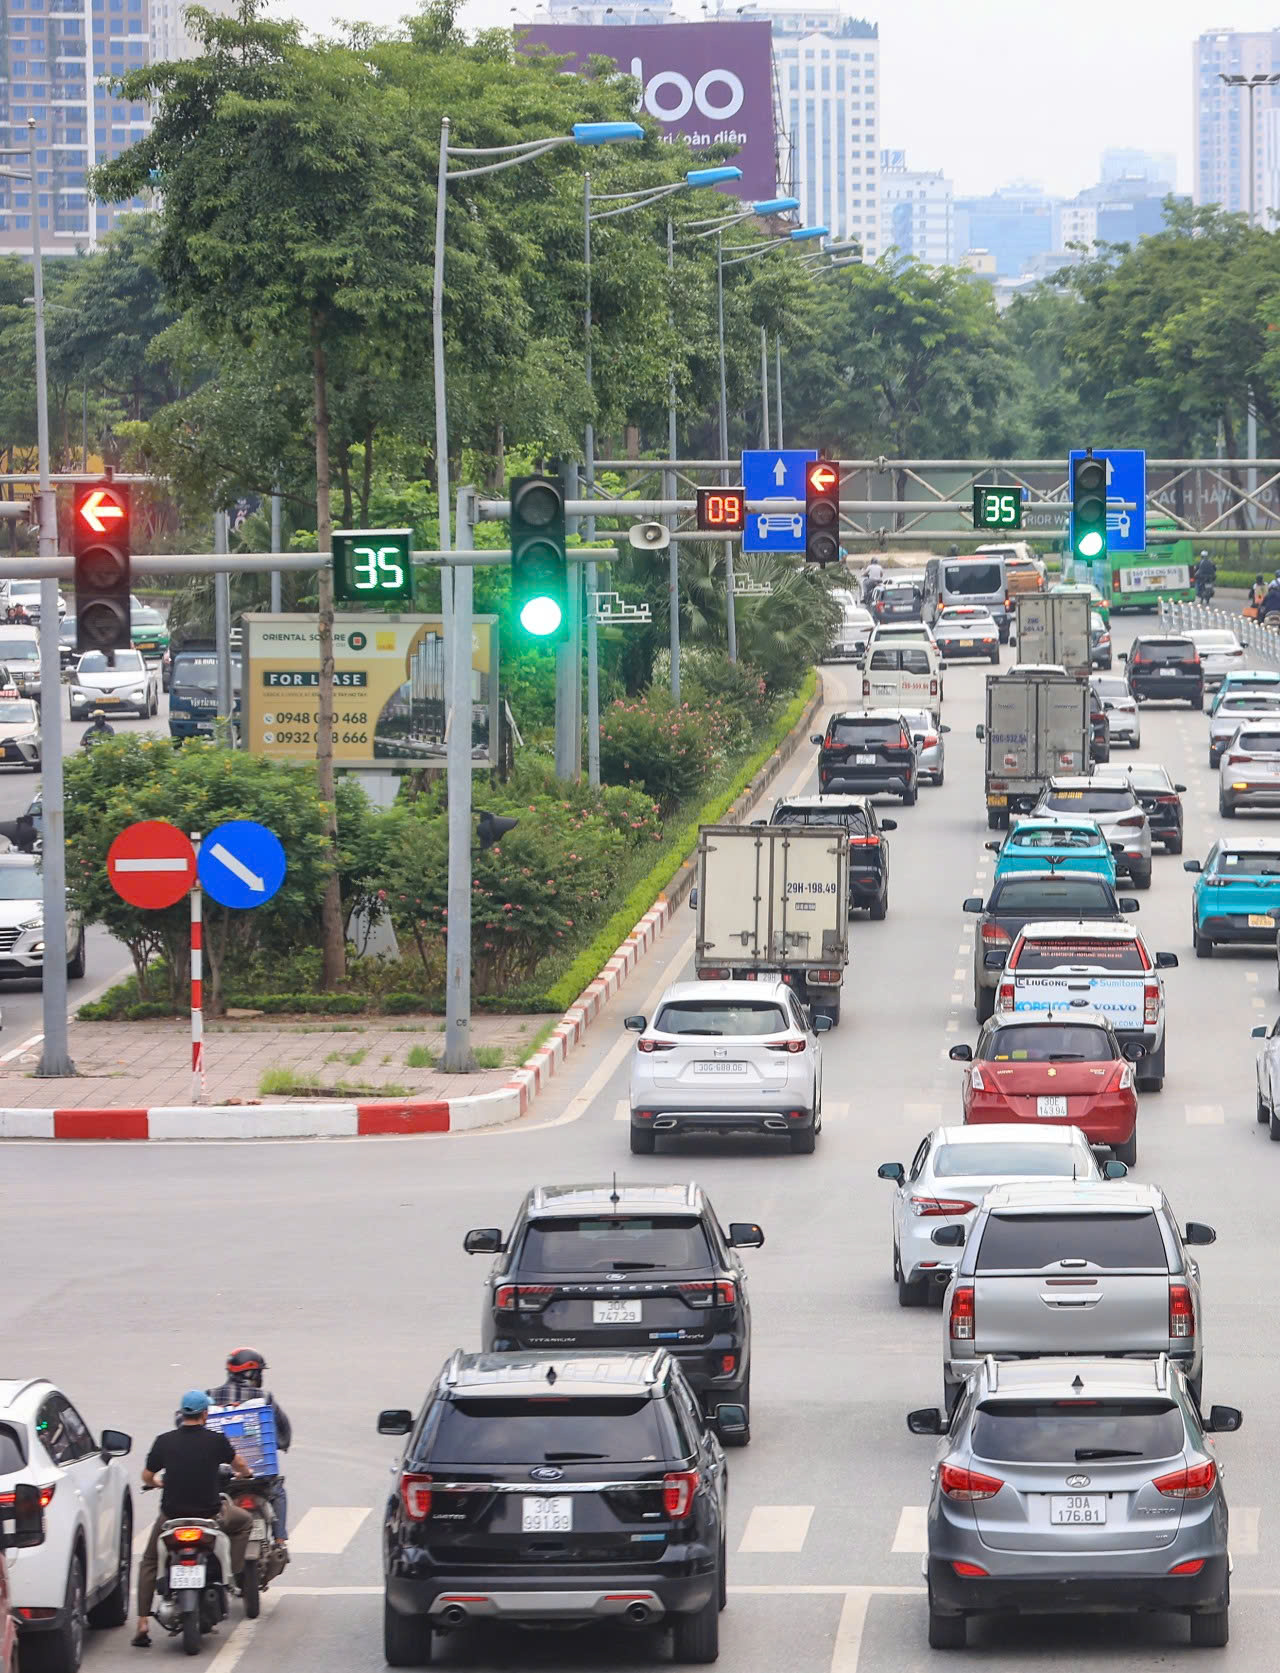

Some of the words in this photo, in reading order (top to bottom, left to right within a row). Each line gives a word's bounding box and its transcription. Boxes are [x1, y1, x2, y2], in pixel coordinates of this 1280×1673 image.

[708, 497, 739, 522] 09
[985, 495, 1015, 522] 35
[354, 547, 403, 589] 35
[262, 633, 306, 641] ORIENTAL
[270, 674, 302, 685] FOR
[311, 674, 361, 685] LASE
[276, 712, 310, 725] 0948
[342, 712, 368, 725] 468
[276, 731, 310, 744] 0932
[342, 731, 368, 744] 666
[787, 882, 836, 894] 29H-198.49
[1100, 979, 1144, 987] Sumitomo
[1093, 1003, 1136, 1012] VOLVO
[1045, 1097, 1059, 1106] 30E
[562, 1284, 670, 1293] EVEREST
[608, 1302, 627, 1312] 30K
[599, 1312, 636, 1322] 747.29
[535, 1499, 560, 1514] 30E
[1067, 1497, 1090, 1508] 30A
[1059, 1510, 1099, 1521] 176.81
[524, 1516, 569, 1530] 991.89
